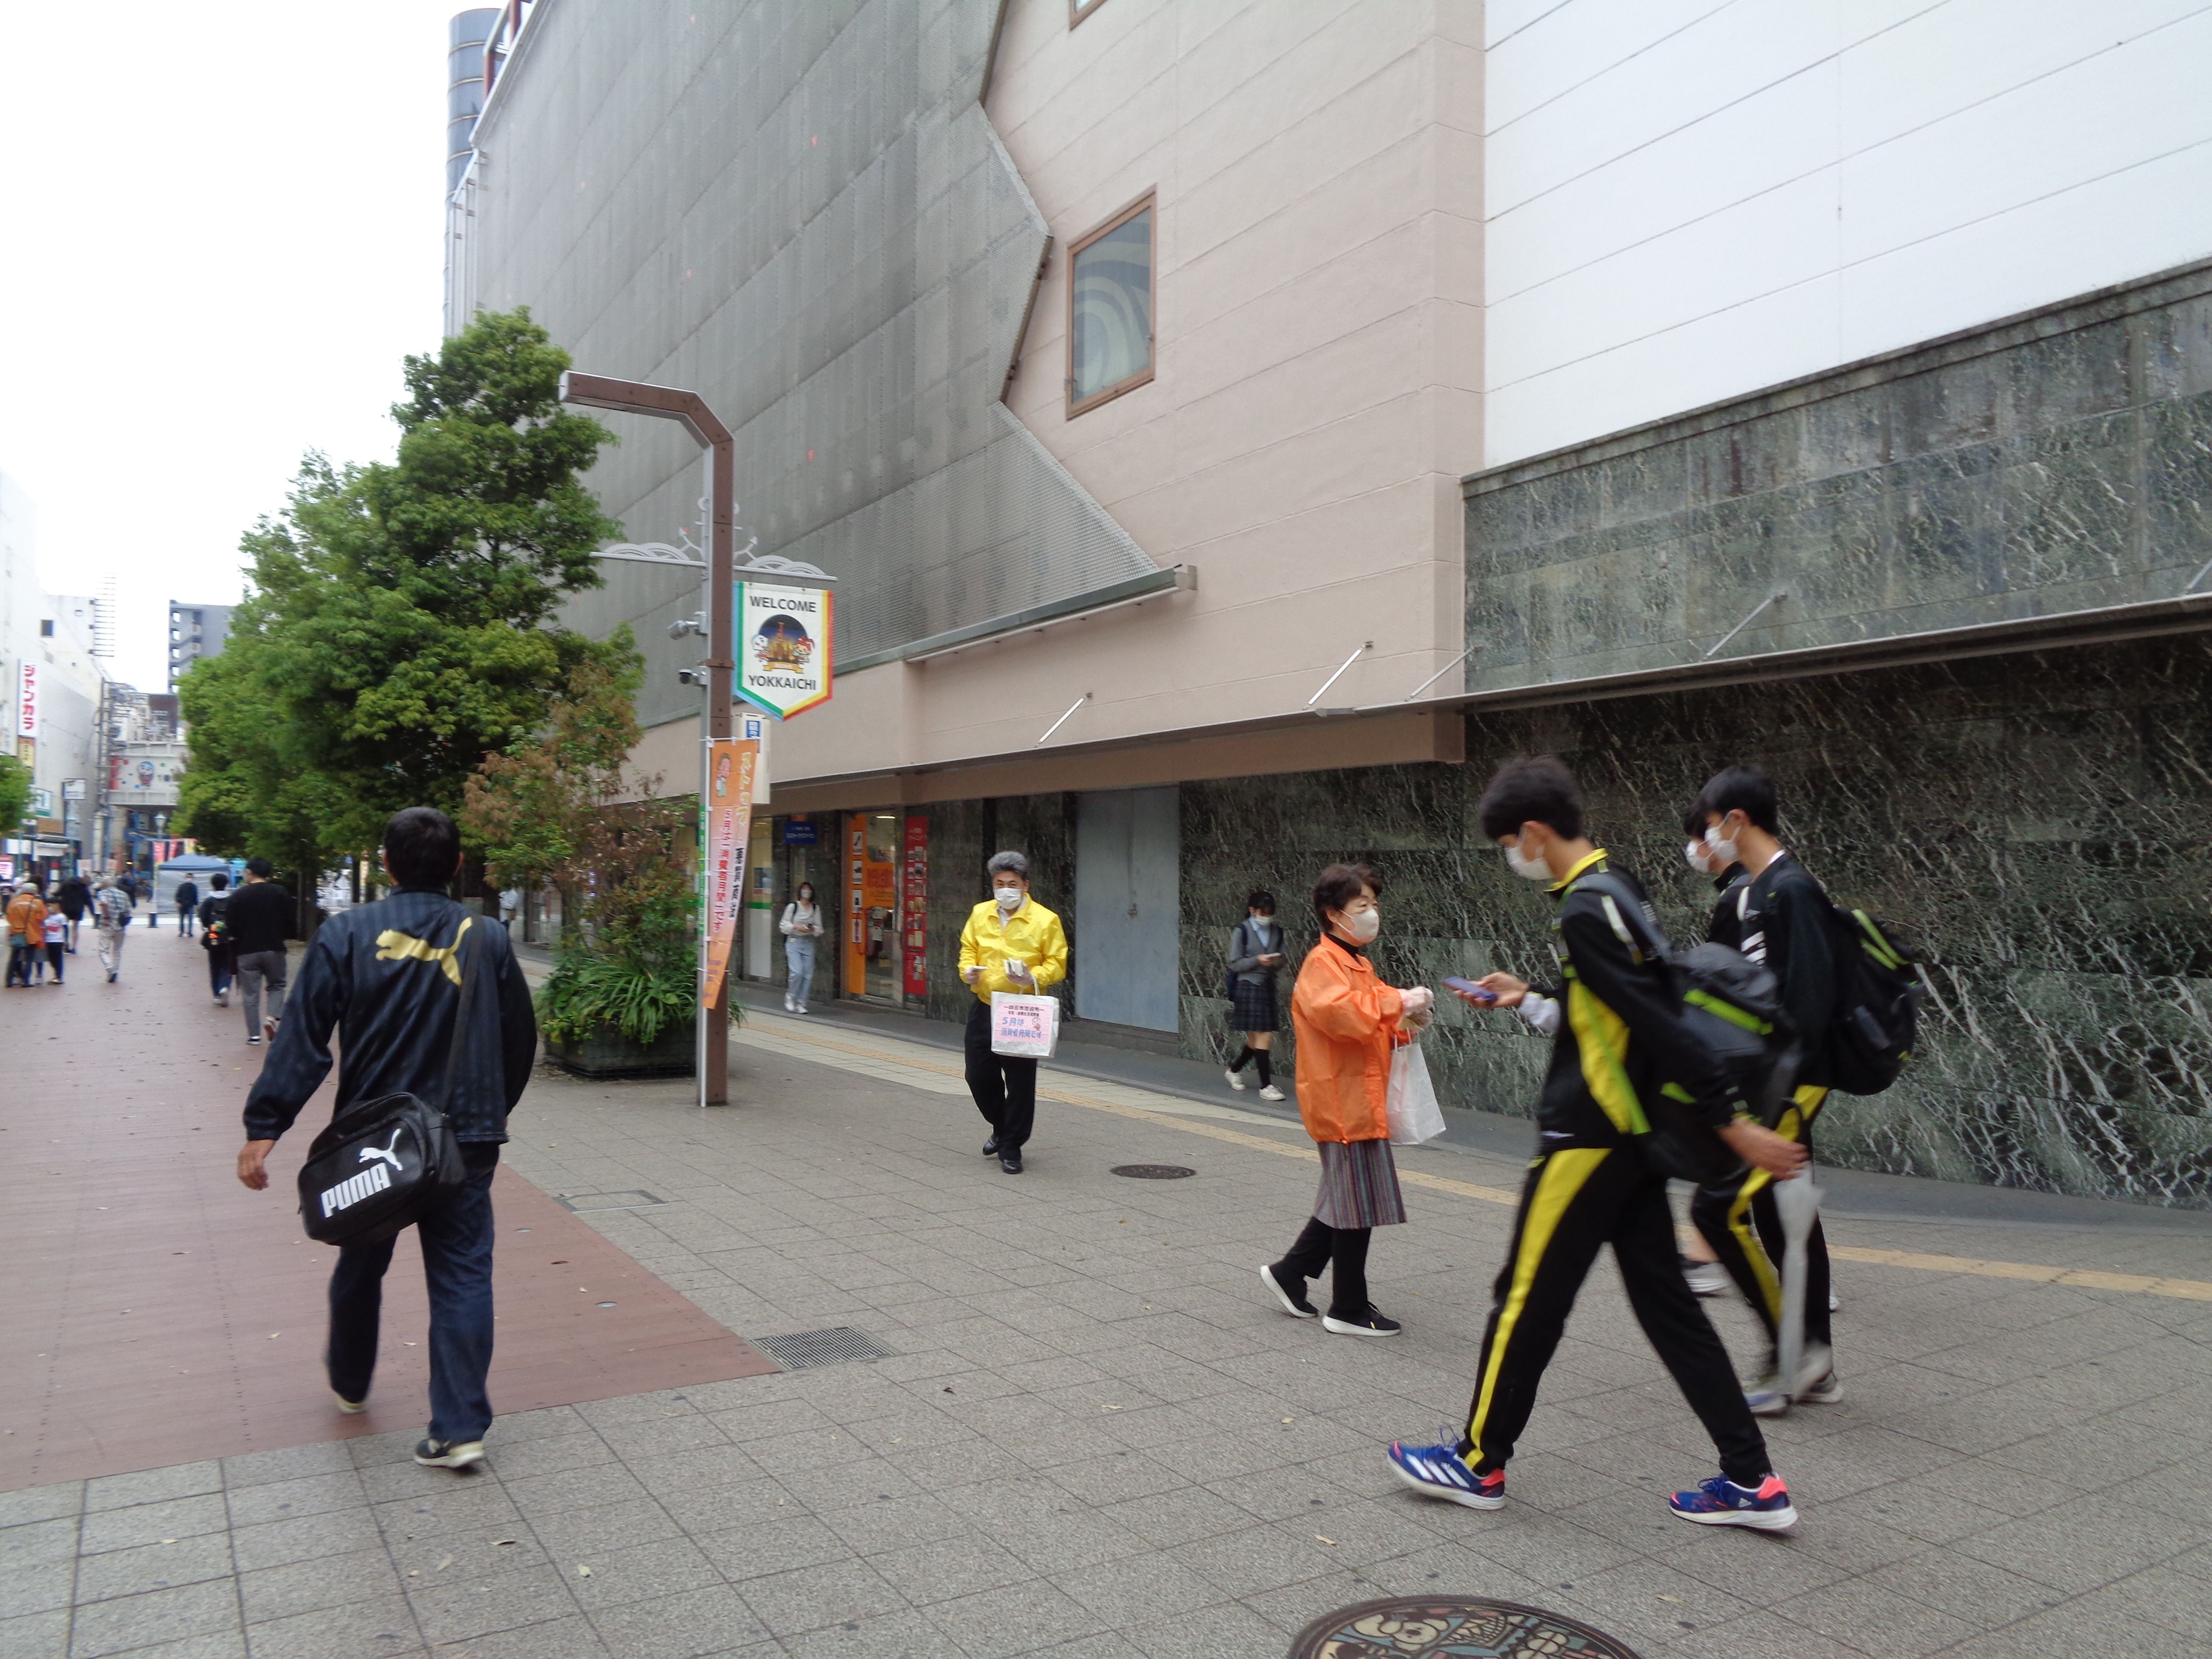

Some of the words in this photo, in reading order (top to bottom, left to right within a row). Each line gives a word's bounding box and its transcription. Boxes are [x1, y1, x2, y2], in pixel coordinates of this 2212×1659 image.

[750, 596, 817, 612] WELCOME
[23, 665, 35, 730] ジャンカラ
[748, 675, 816, 690] YOKKAICHI
[321, 1162, 391, 1218] PUMA
